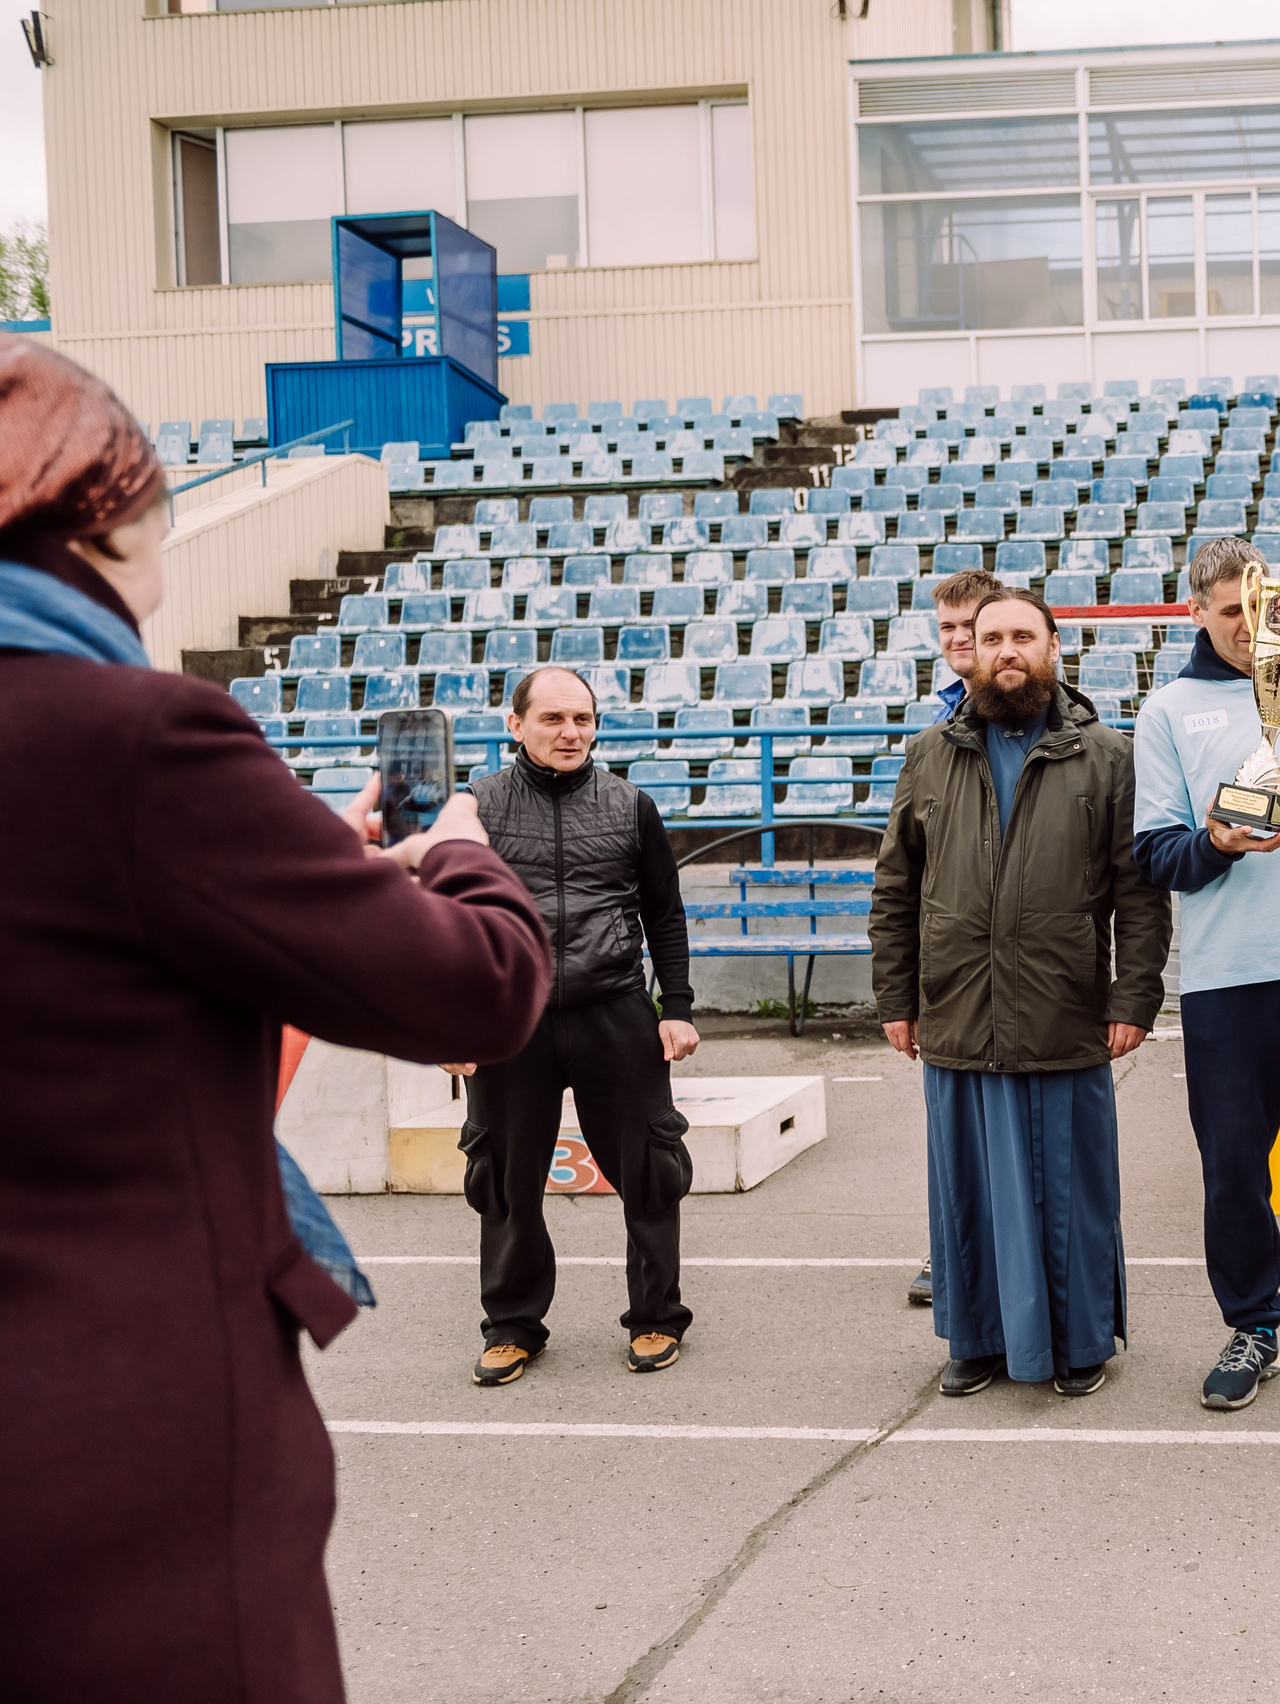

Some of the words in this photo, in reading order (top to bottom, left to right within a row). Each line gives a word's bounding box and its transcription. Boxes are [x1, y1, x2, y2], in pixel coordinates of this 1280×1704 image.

[832, 443, 857, 466] 12
[808, 463, 830, 487] 11
[793, 486, 809, 512] 0
[363, 576, 379, 596] 7
[263, 647, 282, 671] 5
[1192, 715, 1220, 728] 1018
[547, 1138, 598, 1193] 3
